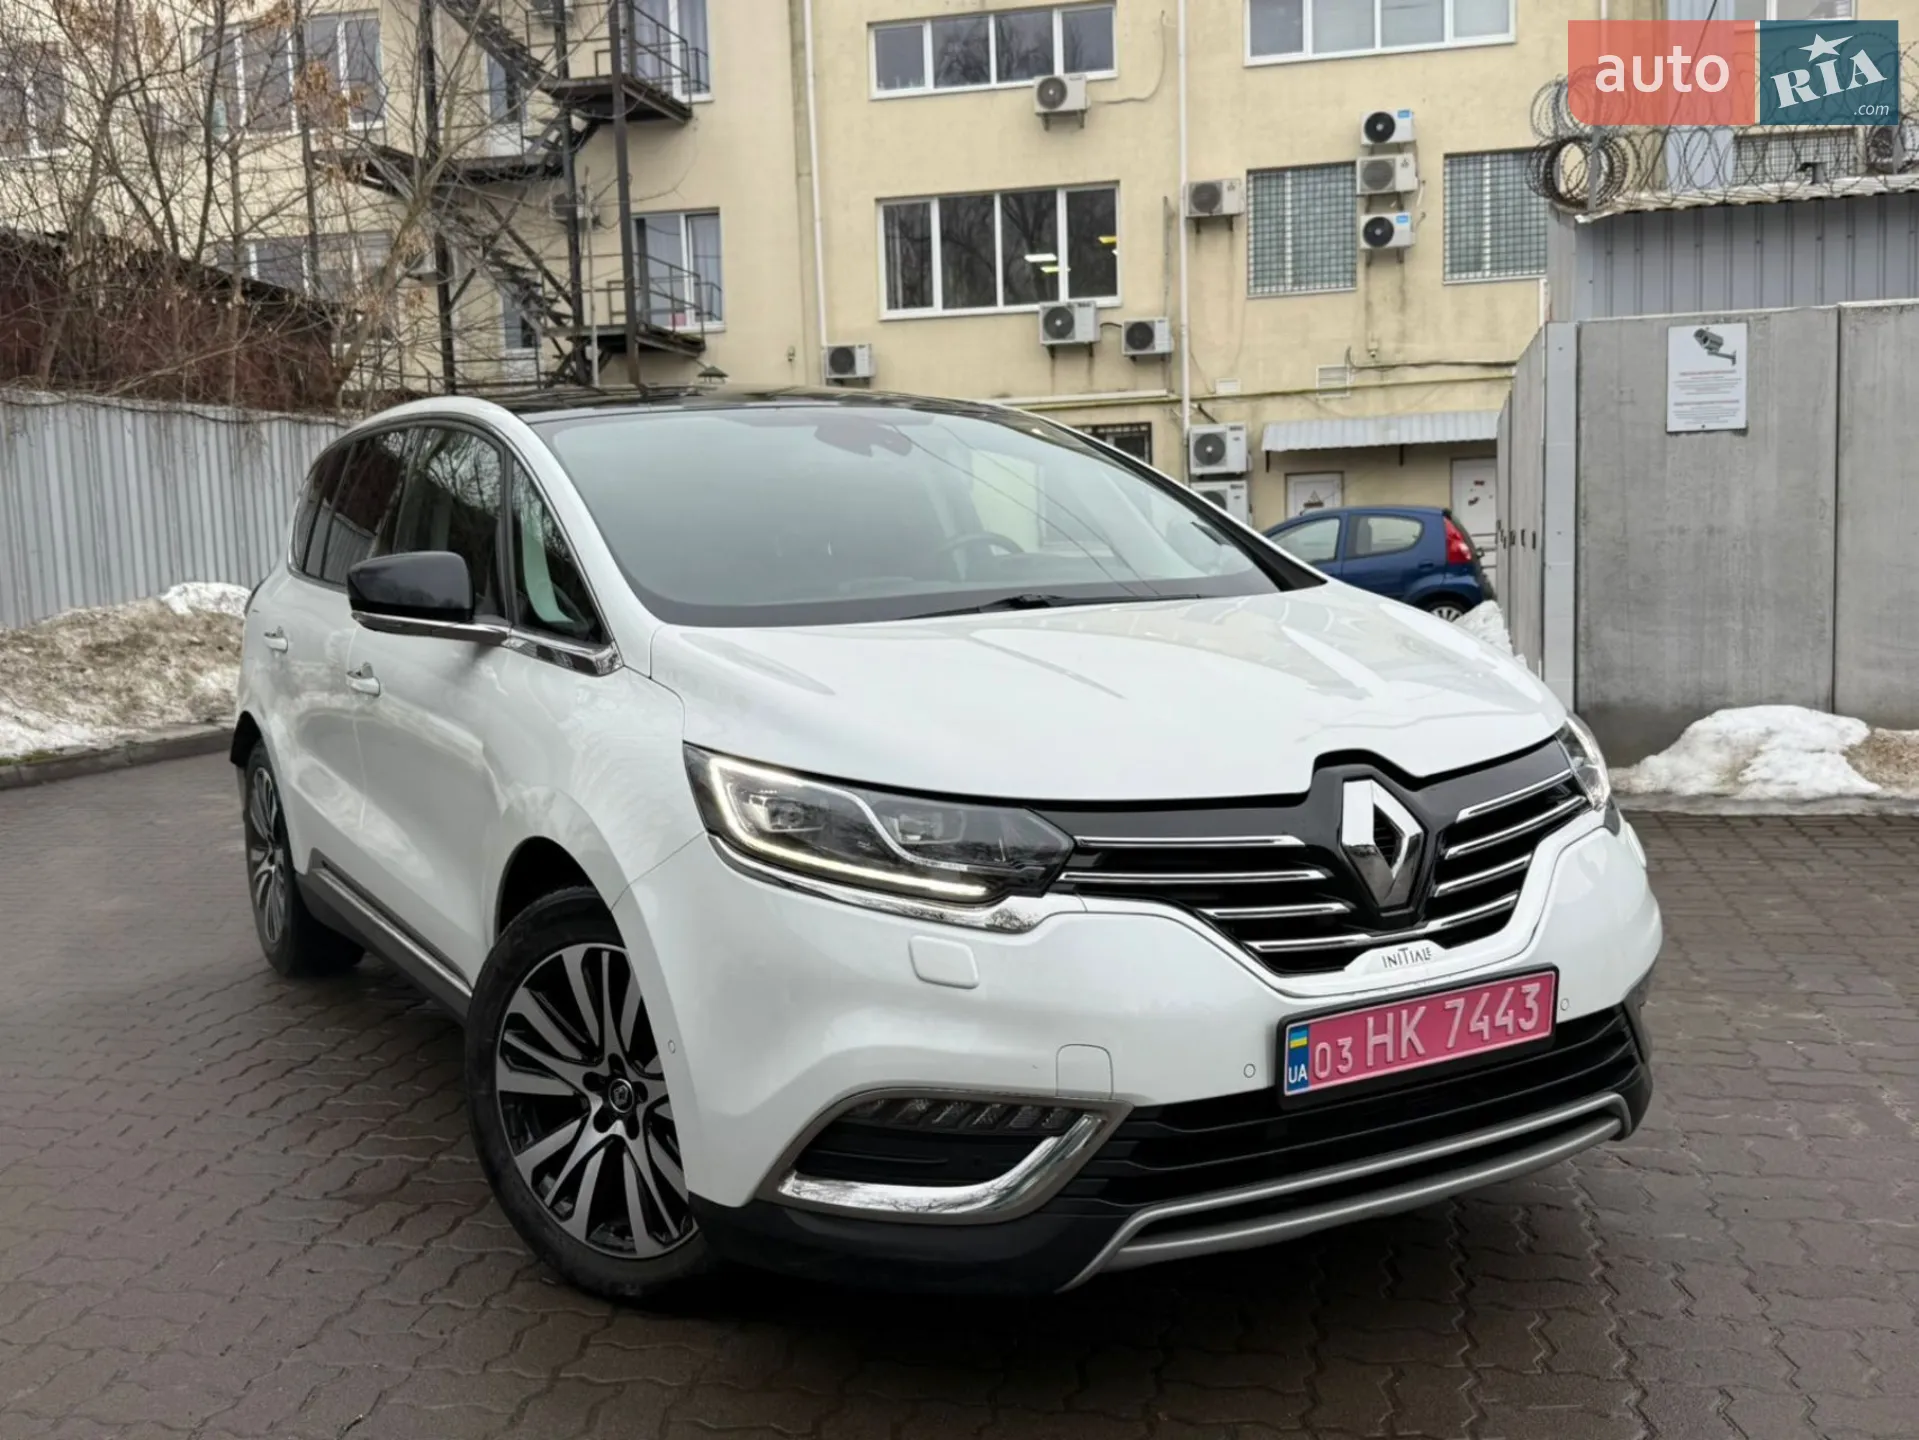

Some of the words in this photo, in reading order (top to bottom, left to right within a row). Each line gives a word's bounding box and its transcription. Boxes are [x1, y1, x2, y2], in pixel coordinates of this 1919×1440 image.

[1381, 946, 1432, 969] INITIALE
[1314, 1036, 1353, 1080] 03
[1366, 1005, 1427, 1068] HK
[1444, 982, 1541, 1049] 7443
[1288, 1064, 1308, 1084] UA
